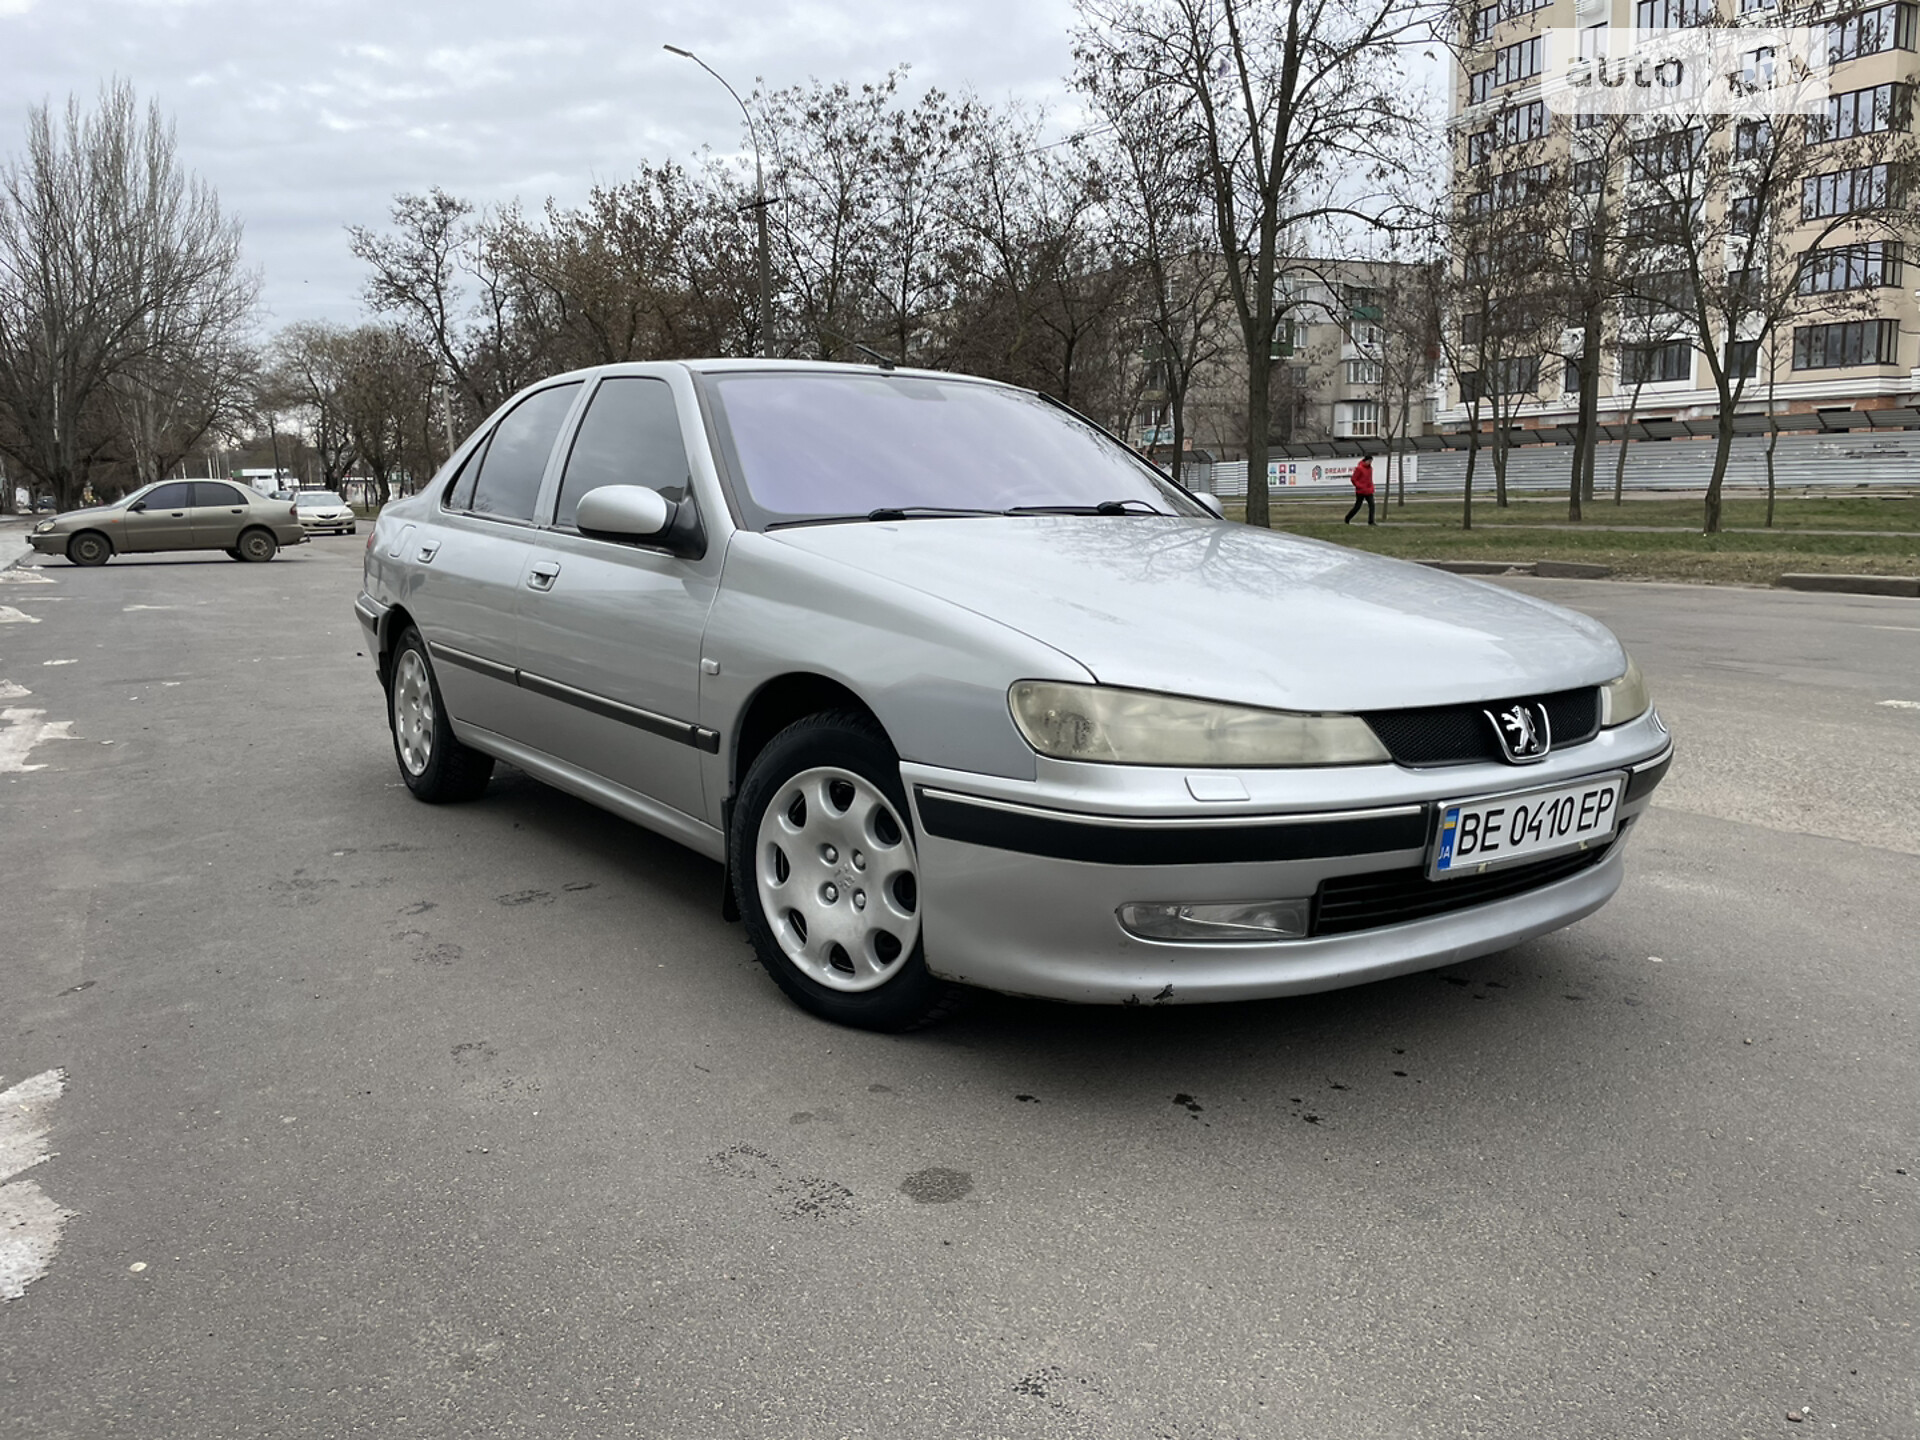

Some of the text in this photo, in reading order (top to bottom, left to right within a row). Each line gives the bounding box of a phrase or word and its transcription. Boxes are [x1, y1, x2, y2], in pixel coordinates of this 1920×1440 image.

[1457, 787, 1614, 856] BE 0410 EP
